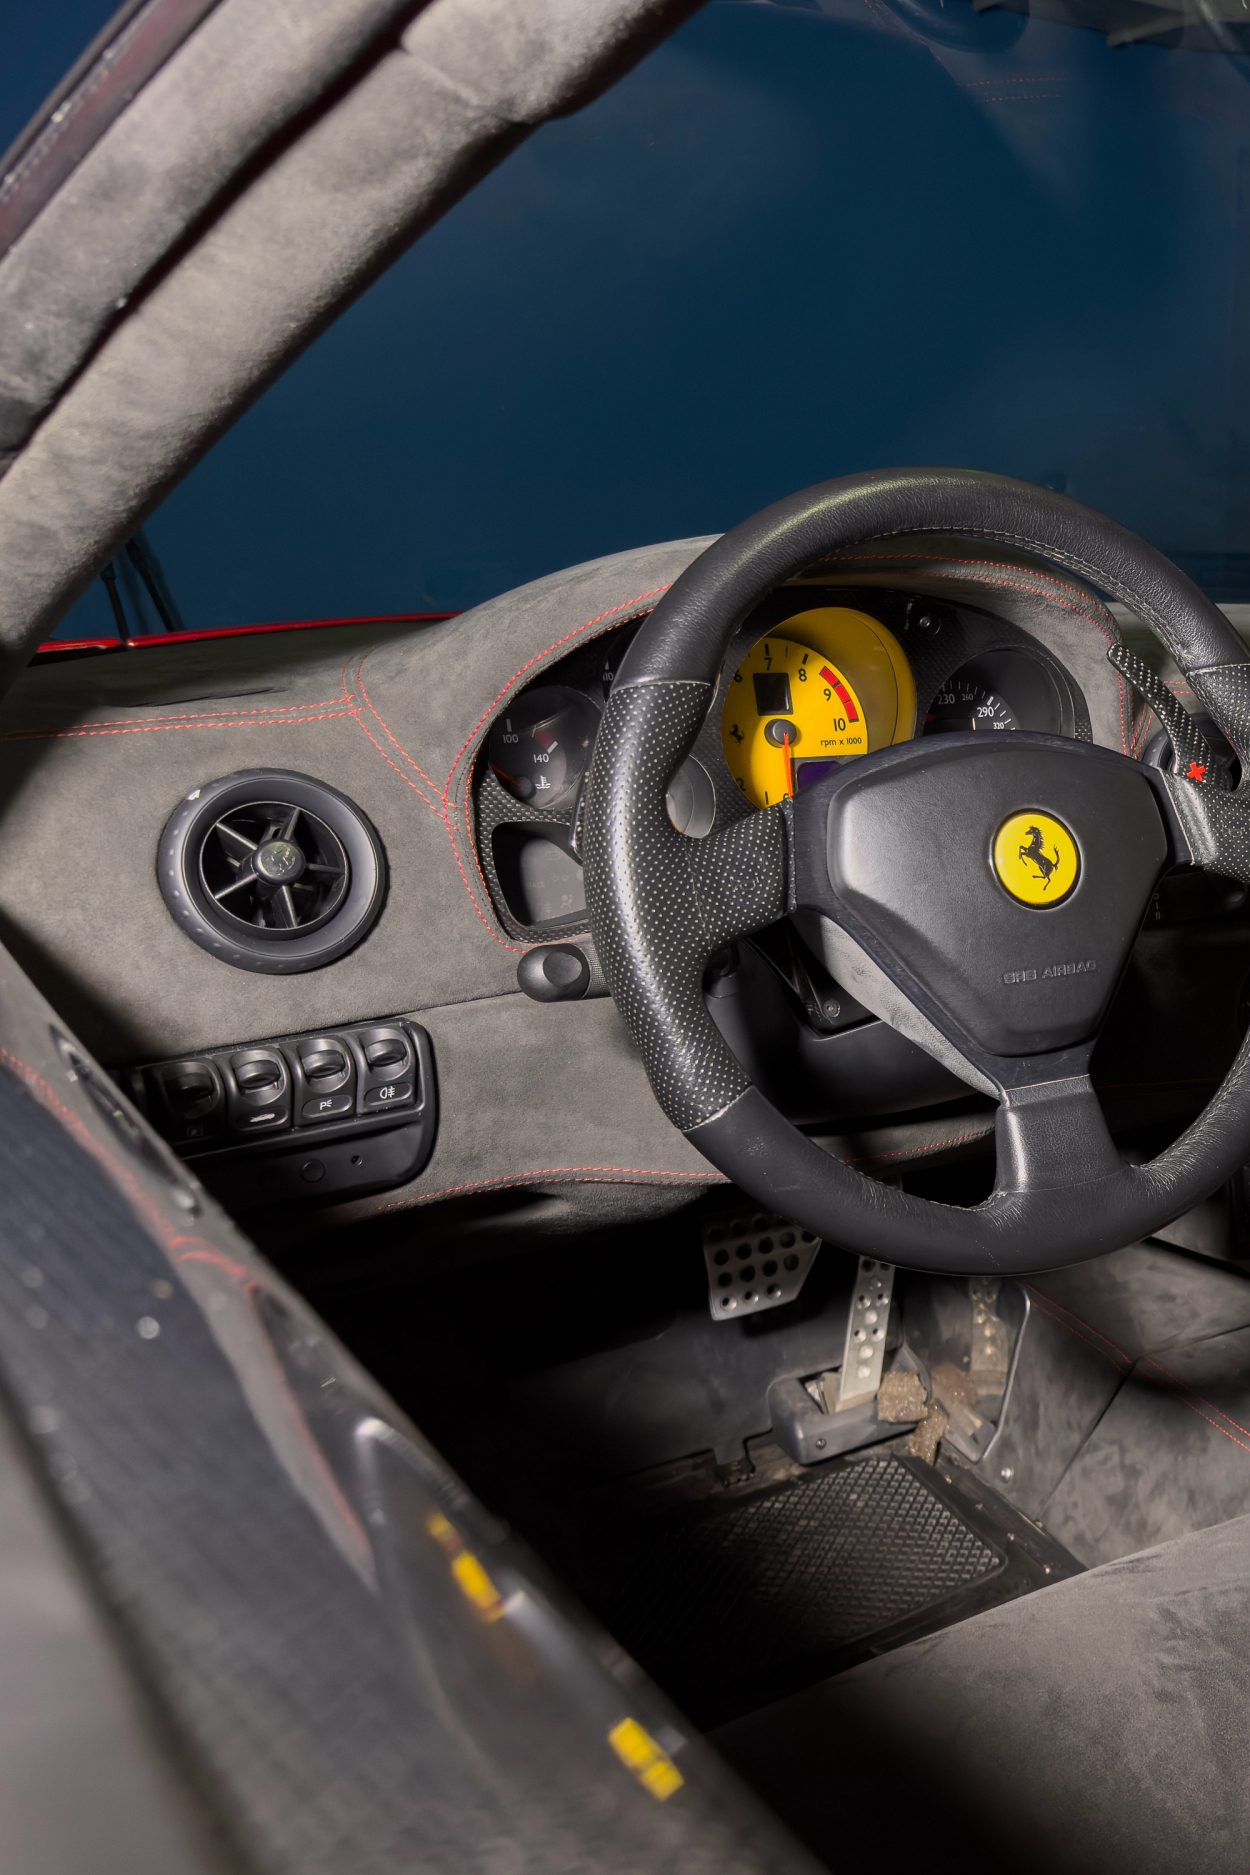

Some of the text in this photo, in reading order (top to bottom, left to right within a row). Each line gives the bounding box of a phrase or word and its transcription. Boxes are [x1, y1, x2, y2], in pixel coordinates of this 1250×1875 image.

[764, 657, 772, 671] 7
[798, 668, 808, 682] 8
[823, 688, 832, 701] 9
[938, 693, 956, 705] 230
[976, 706, 994, 718] 290
[833, 717, 846, 732] 10
[993, 721, 1005, 730] 320
[502, 734, 519, 744] 100
[820, 738, 837, 748] rpm
[846, 736, 862, 745] 1000
[533, 753, 550, 763] 140
[1042, 959, 1097, 979] AIRBAG
